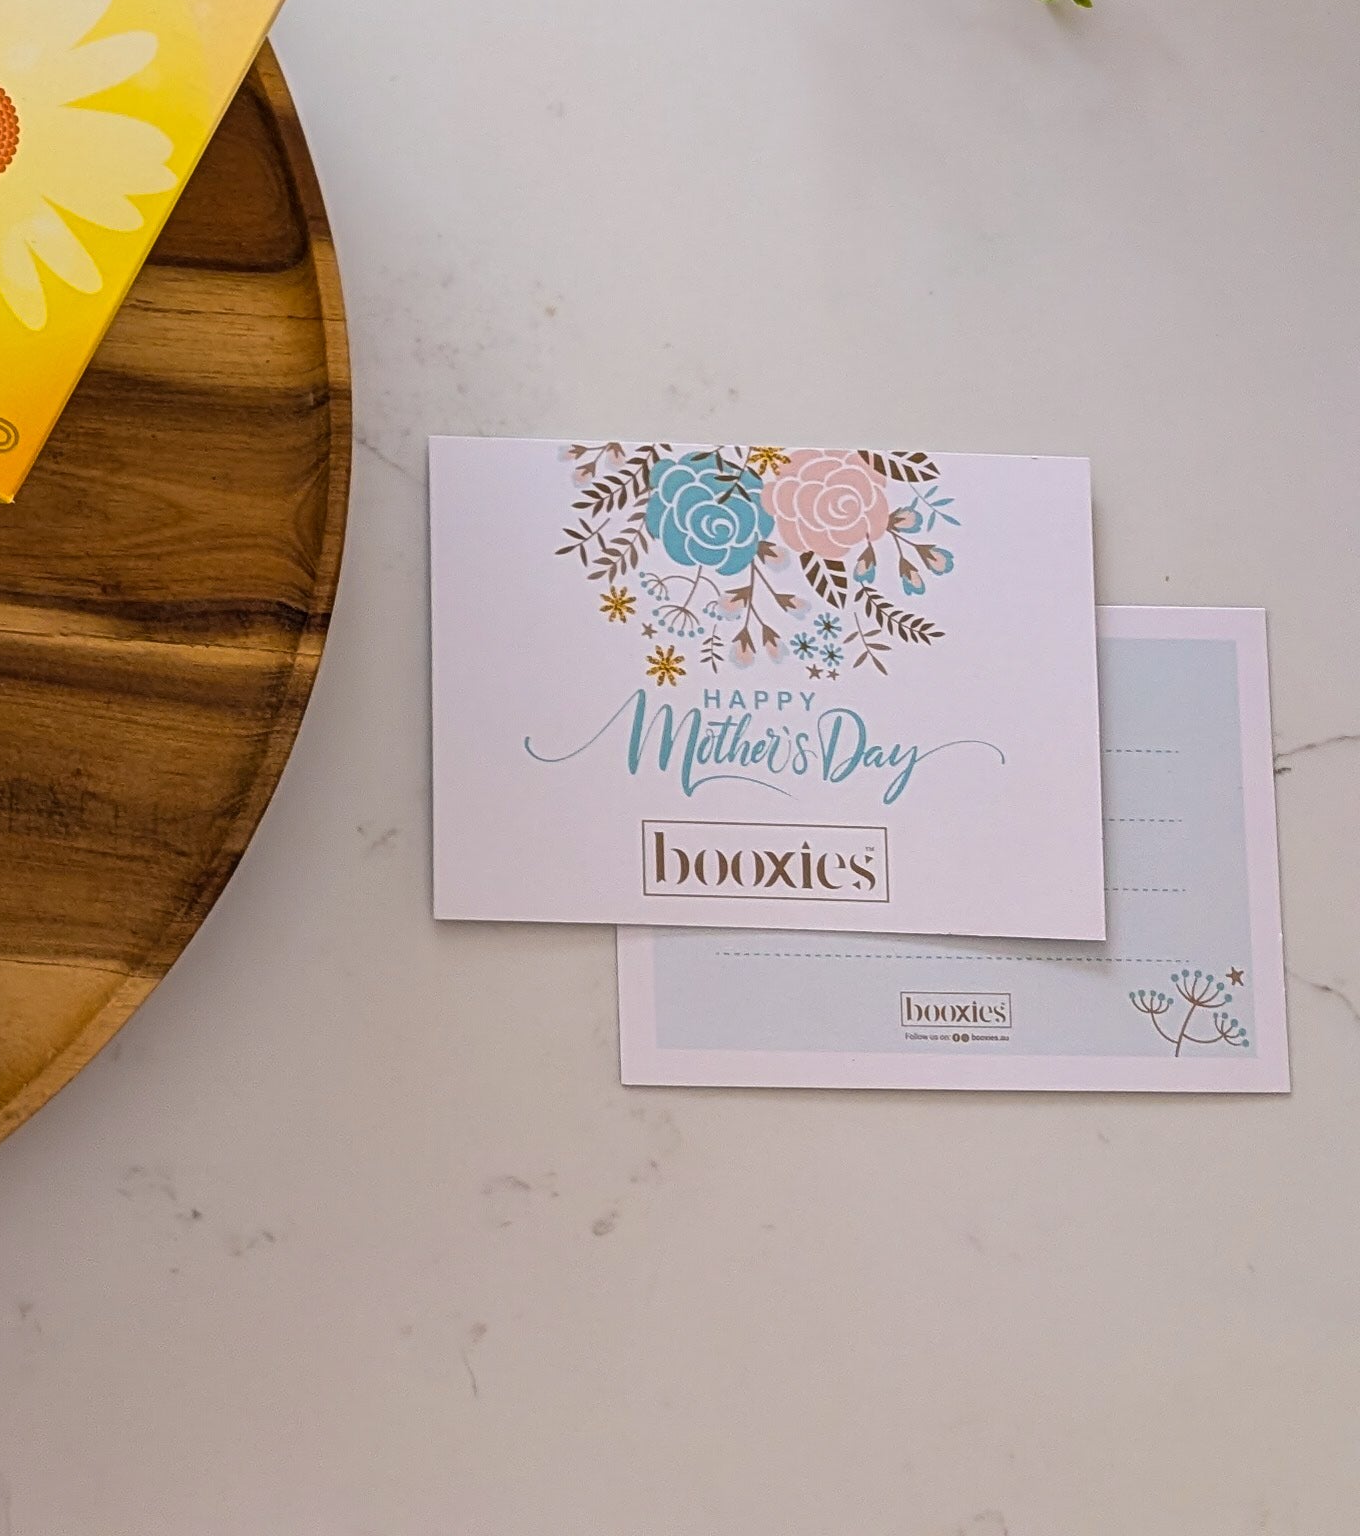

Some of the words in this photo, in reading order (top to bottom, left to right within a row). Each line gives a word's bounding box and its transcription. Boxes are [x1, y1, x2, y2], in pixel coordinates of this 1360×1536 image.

[704, 688, 816, 712] HAPPY
[524, 688, 818, 800] Mother's
[905, 1032, 929, 1041] Follow
